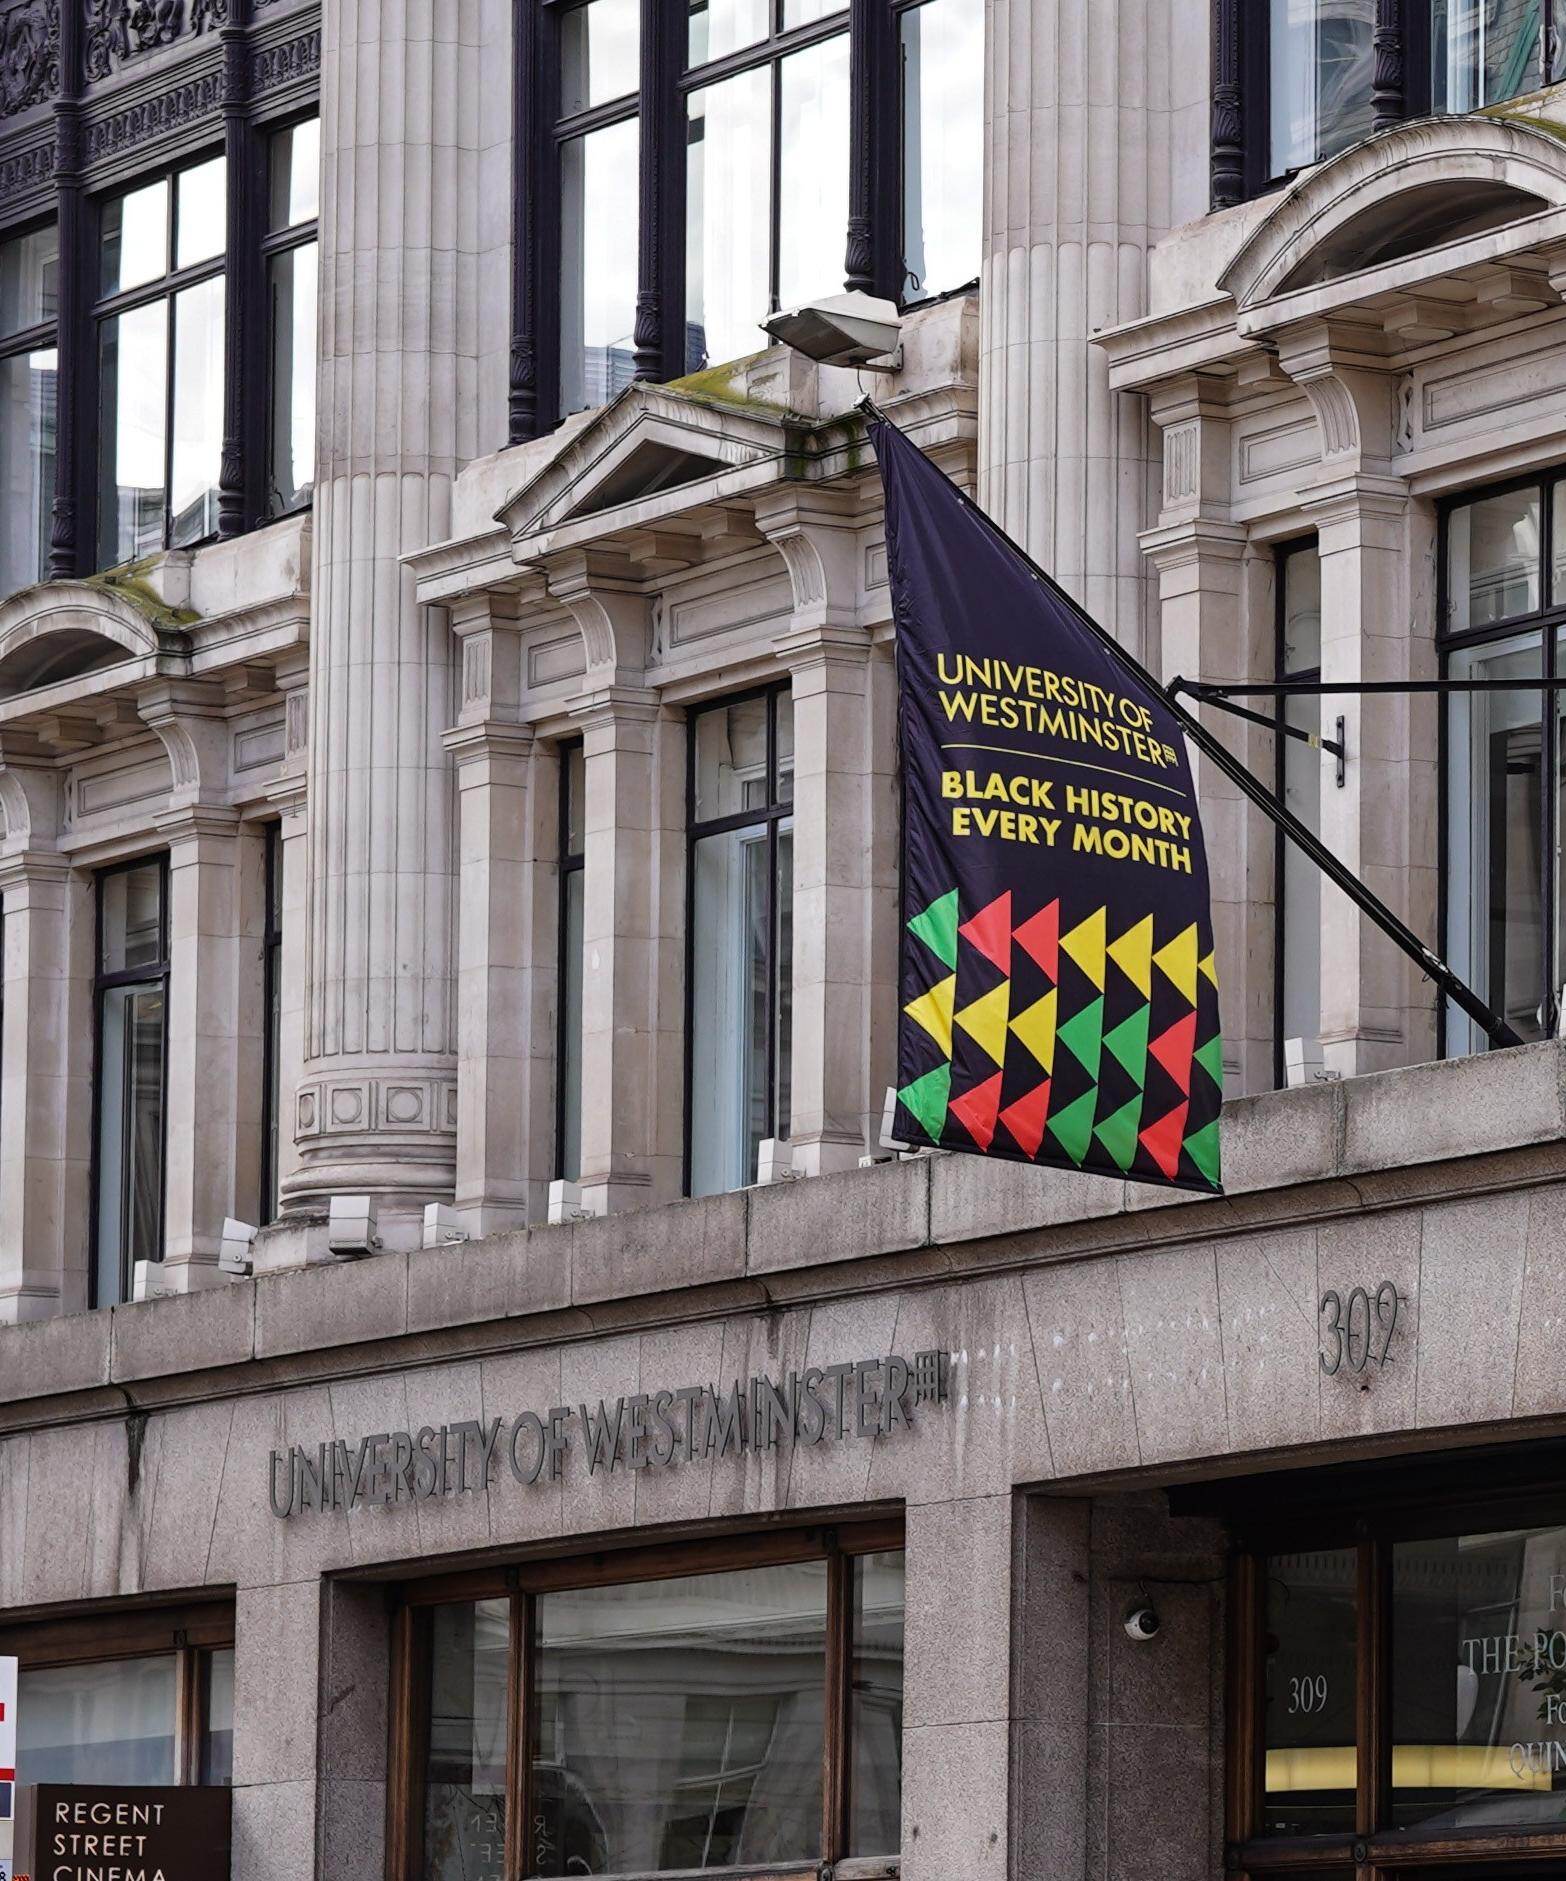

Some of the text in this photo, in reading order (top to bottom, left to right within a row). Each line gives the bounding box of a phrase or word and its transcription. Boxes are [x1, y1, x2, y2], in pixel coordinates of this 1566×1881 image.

[937, 653, 1155, 733] UNIVERSITY OF
[938, 690, 1168, 769] WESTMINSTER
[941, 769, 1193, 841] BLACK HISTORY
[952, 807, 1193, 875] EVERY MONTH
[1320, 1280, 1398, 1376] 309
[269, 1355, 911, 1519] UNIVERSITY OF WESTMINSTER
[1463, 1634, 1521, 1676] THE
[1287, 1674, 1328, 1714] 309
[53, 1833, 147, 1857] STREET
[55, 1802, 165, 1826] REGENT
[53, 1865, 167, 1881] CINEMA
